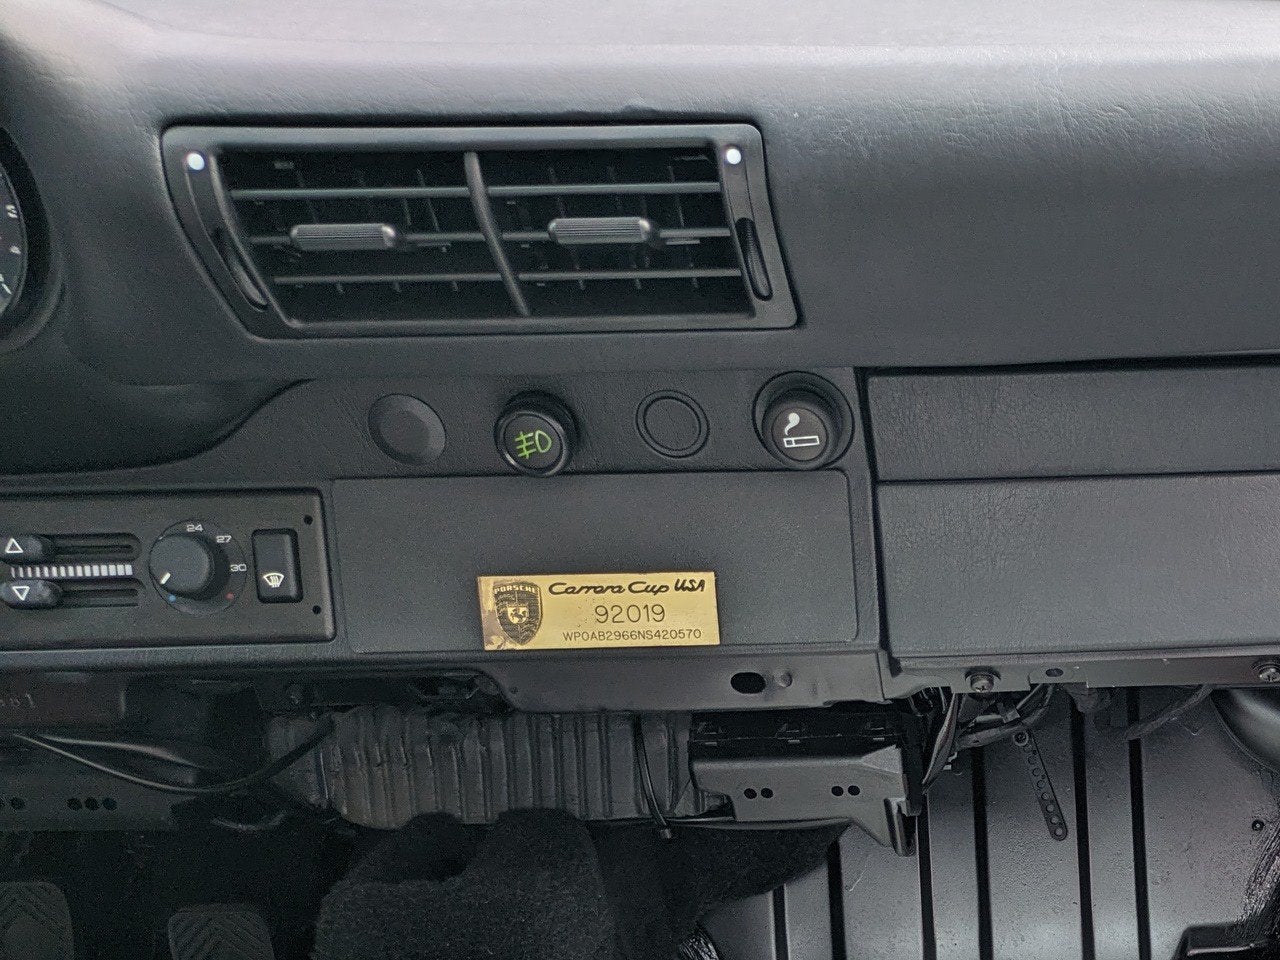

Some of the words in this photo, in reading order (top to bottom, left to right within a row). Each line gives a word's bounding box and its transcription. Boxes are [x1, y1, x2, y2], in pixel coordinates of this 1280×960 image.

[186, 524, 204, 532] 24
[215, 535, 232, 543] 27
[230, 564, 247, 572] 30
[548, 581, 625, 596] Carrera
[628, 580, 670, 596] Cup
[674, 578, 705, 593] USA
[593, 603, 666, 624] 92019
